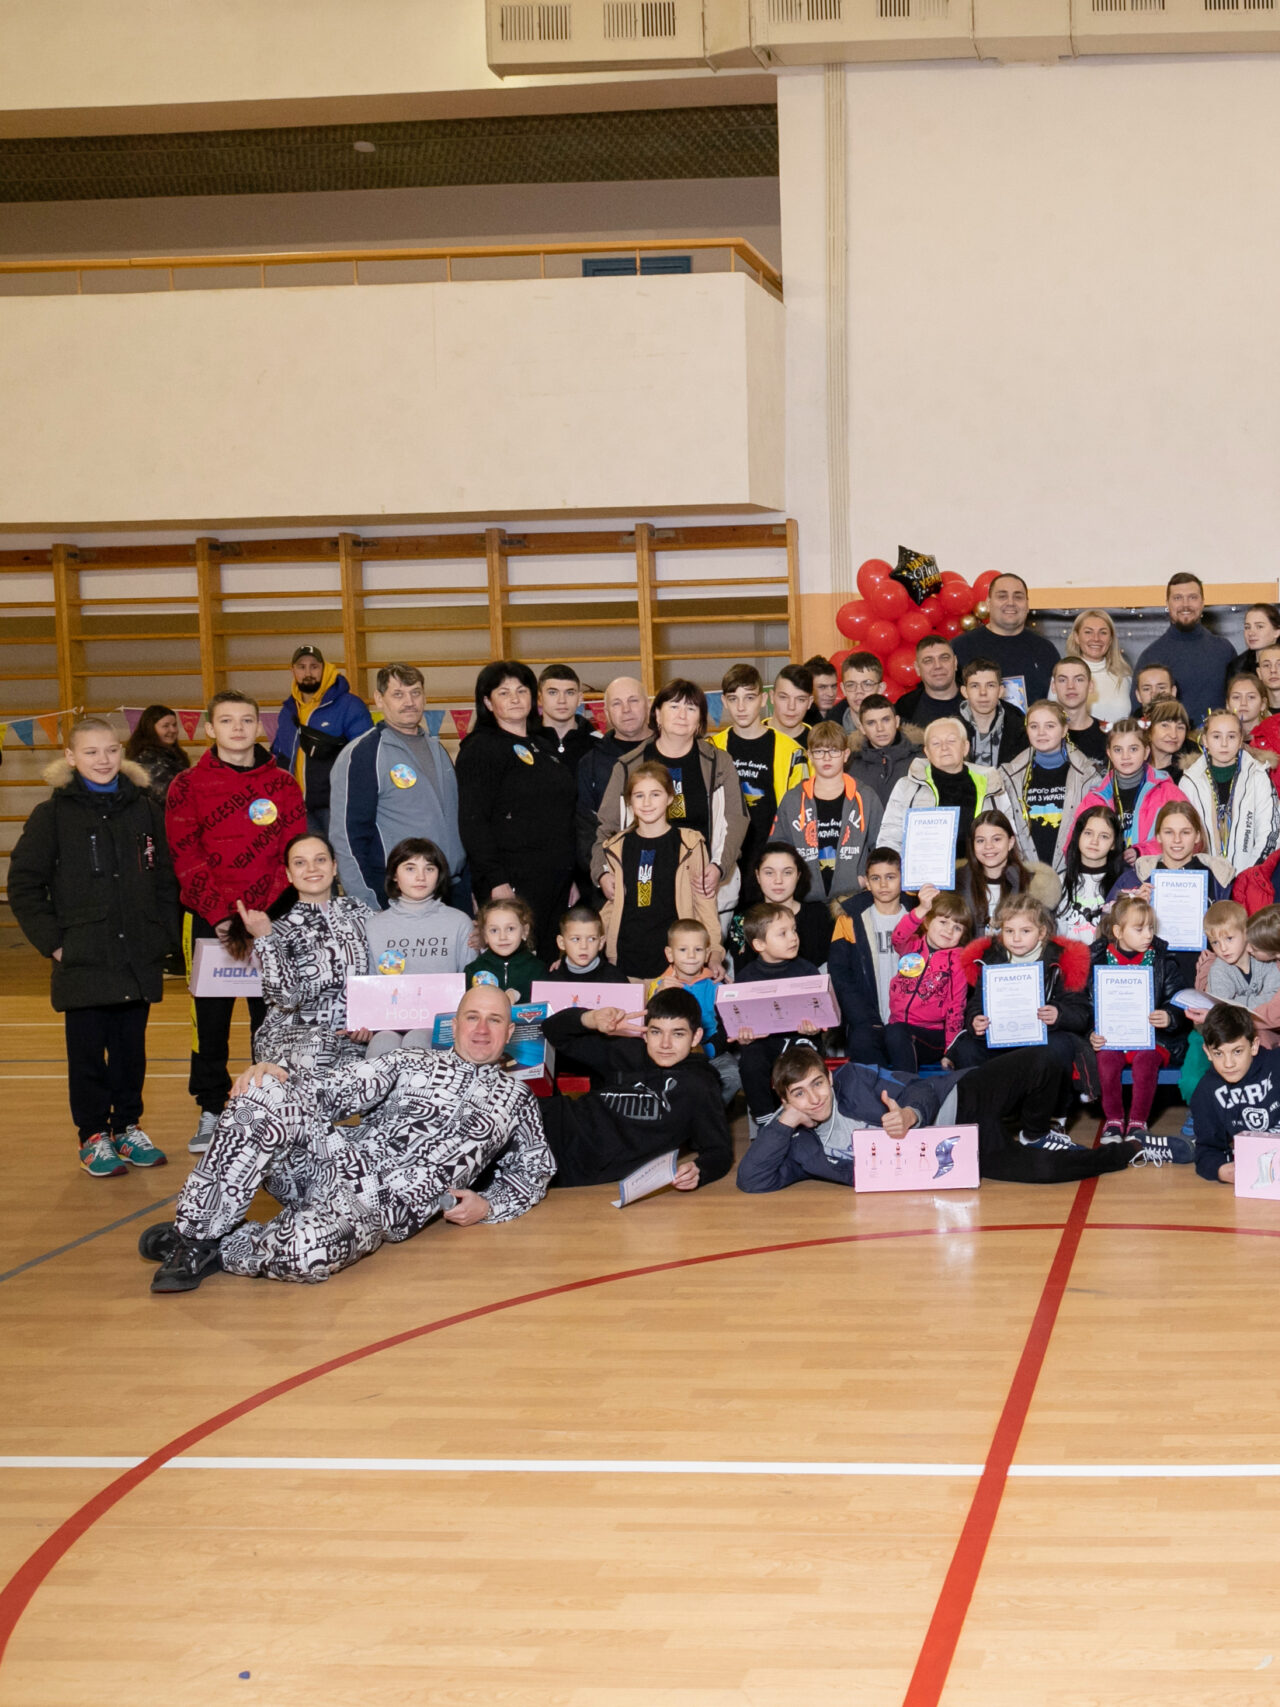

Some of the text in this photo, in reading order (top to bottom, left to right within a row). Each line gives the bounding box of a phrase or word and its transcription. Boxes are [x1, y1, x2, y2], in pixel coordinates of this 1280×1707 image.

[1161, 881, 1198, 889] ГРАМОТА
[387, 937, 449, 949] DO NOT
[385, 947, 449, 958] STURB
[213, 967, 259, 978] HOOLA
[994, 974, 1032, 983] ГРАМОТА
[386, 1007, 430, 1021] Hoop
